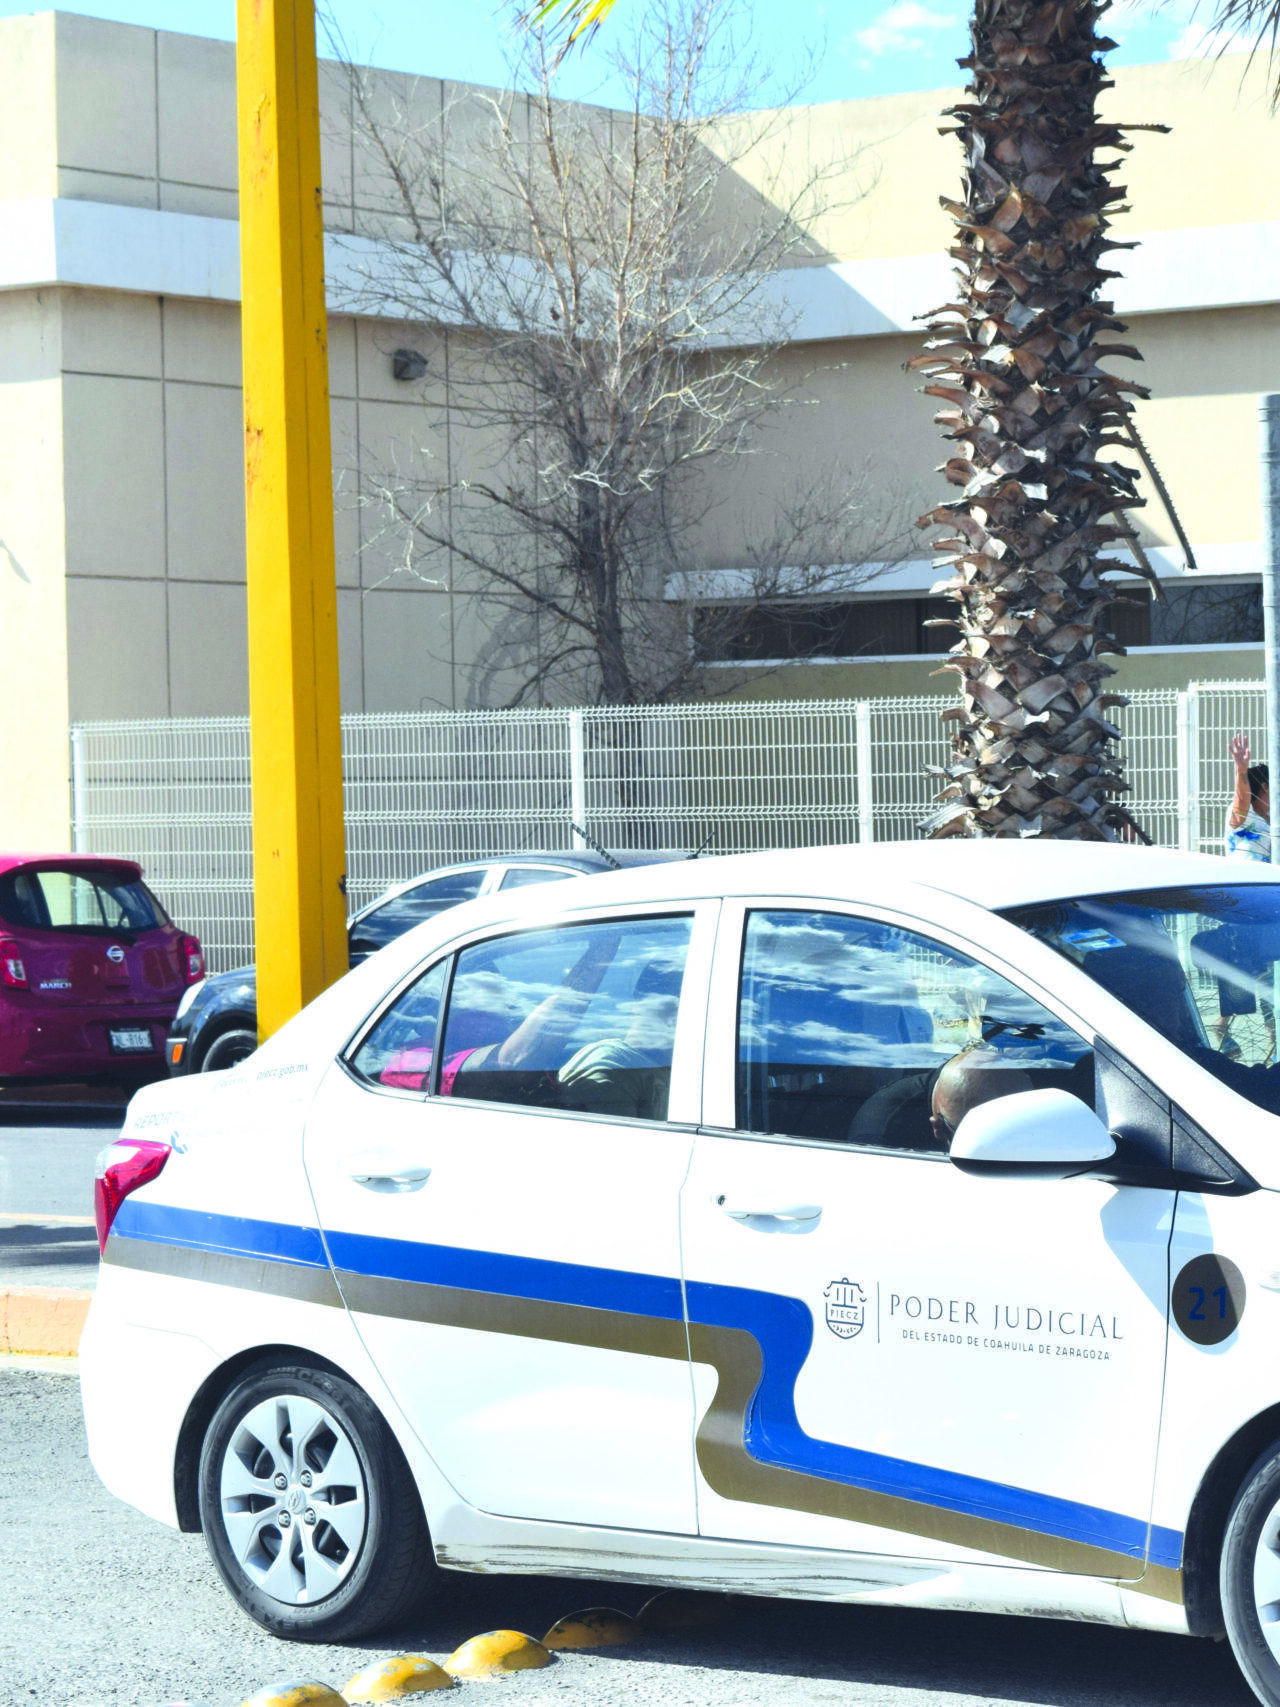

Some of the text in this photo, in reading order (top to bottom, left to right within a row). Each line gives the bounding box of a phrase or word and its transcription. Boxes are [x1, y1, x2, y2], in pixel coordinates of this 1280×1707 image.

[889, 1294, 1125, 1341] PODER JUDICIAL
[1187, 1286, 1228, 1321] 21
[902, 1329, 1111, 1361] DEL ESTADO DE COAHUILA DE ZARAGOZA
